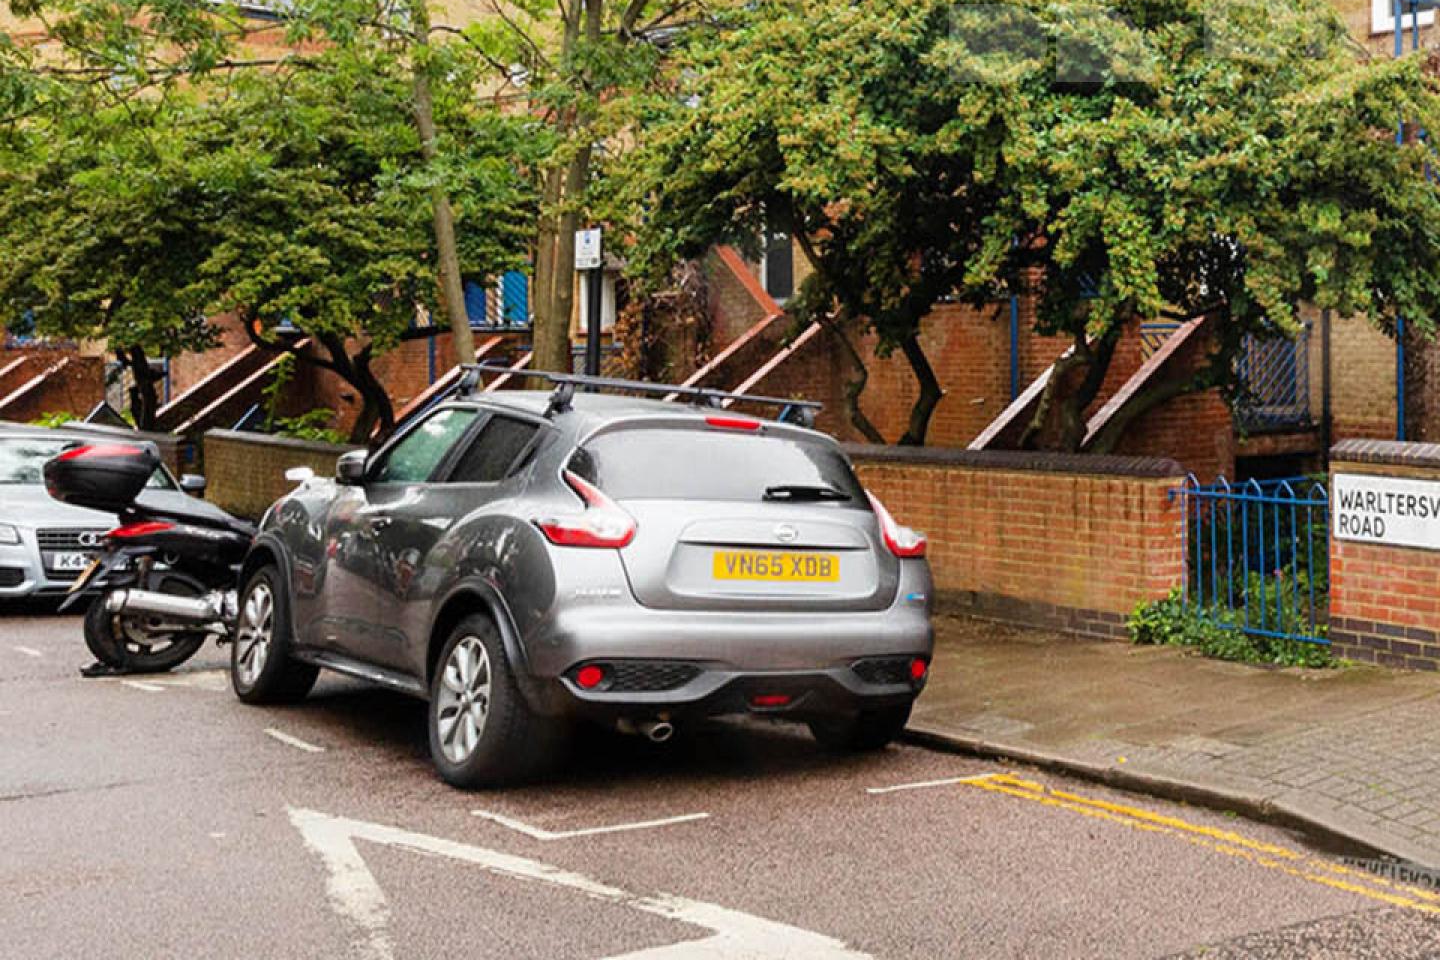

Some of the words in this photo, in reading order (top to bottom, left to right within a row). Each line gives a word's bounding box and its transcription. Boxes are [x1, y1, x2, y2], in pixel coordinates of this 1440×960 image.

[1338, 514, 1386, 538] ROAD
[725, 554, 783, 576] VN65
[790, 557, 832, 577] XDB
